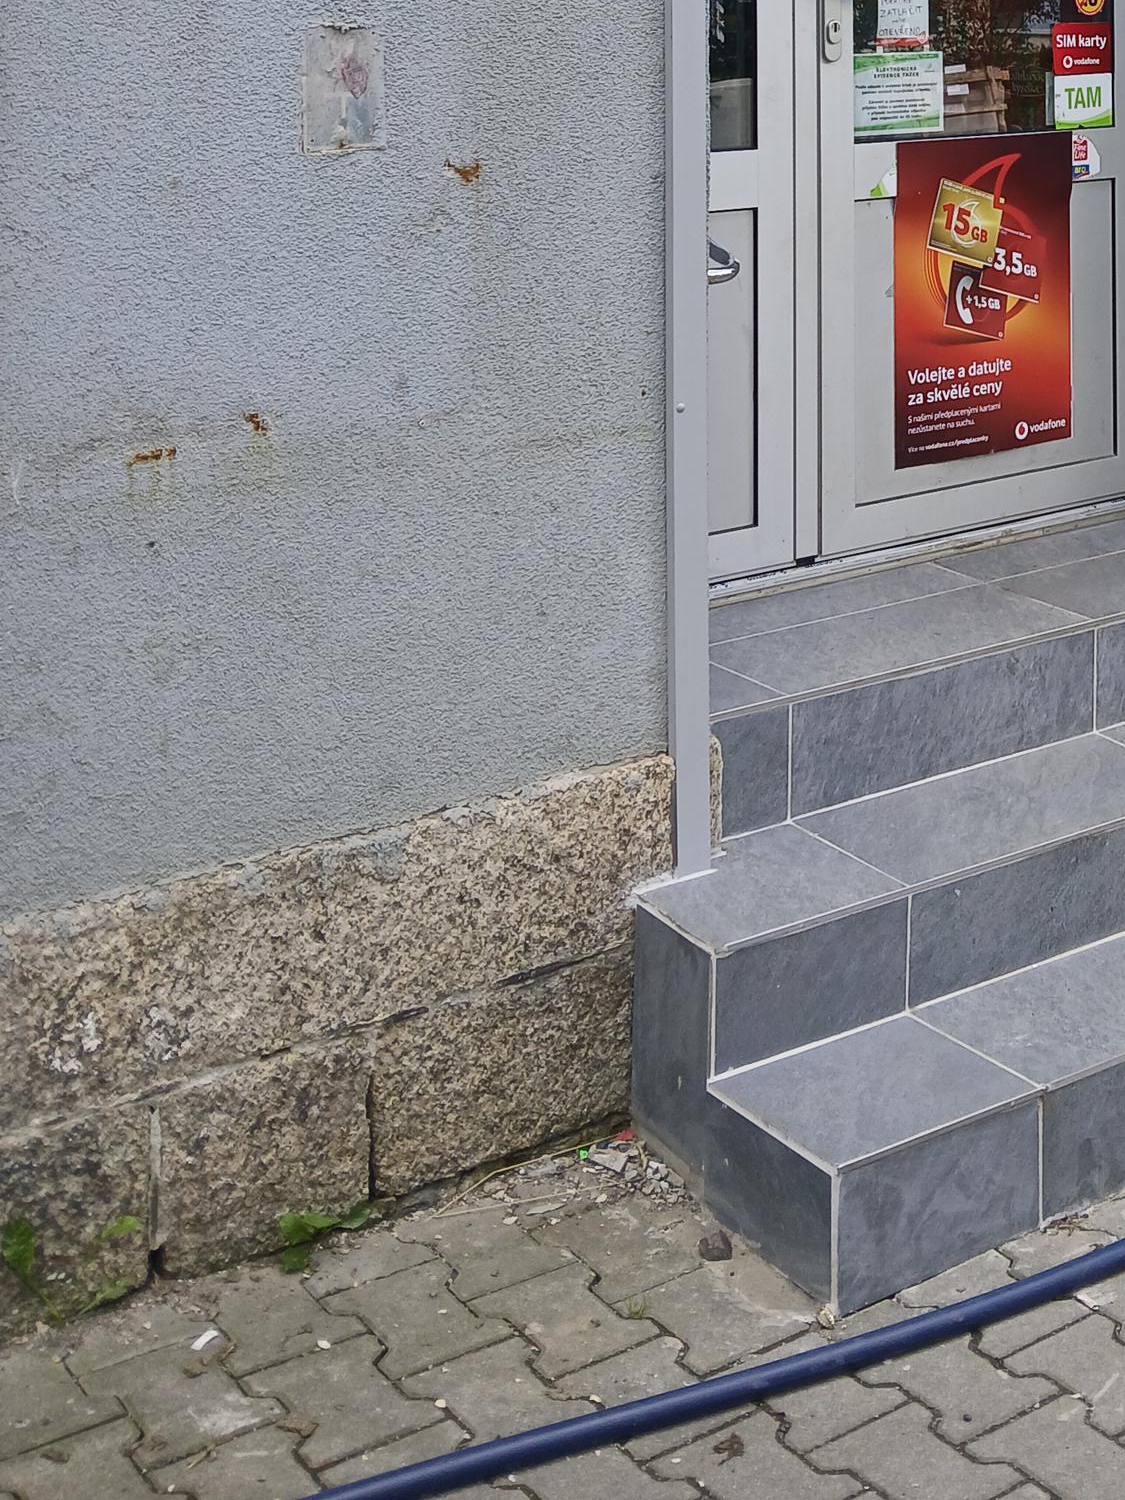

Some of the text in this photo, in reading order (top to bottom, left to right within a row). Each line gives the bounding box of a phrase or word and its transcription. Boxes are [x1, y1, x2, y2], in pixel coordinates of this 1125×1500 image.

[1056, 34, 1107, 50] SIM karty
[1073, 57, 1100, 66] vodafone
[1064, 86, 1102, 110] TAM
[942, 202, 972, 236] 15
[971, 226, 988, 244] GB
[994, 247, 1037, 277] 3,5 GB
[988, 297, 1001, 310] GB
[907, 357, 1012, 385] Volejte a datujte
[907, 380, 1003, 406] za skvělé ceny
[907, 414, 913, 424] S
[934, 404, 979, 421] předplacenými
[947, 420, 955, 429] na
[1029, 418, 1066, 434] vodafone
